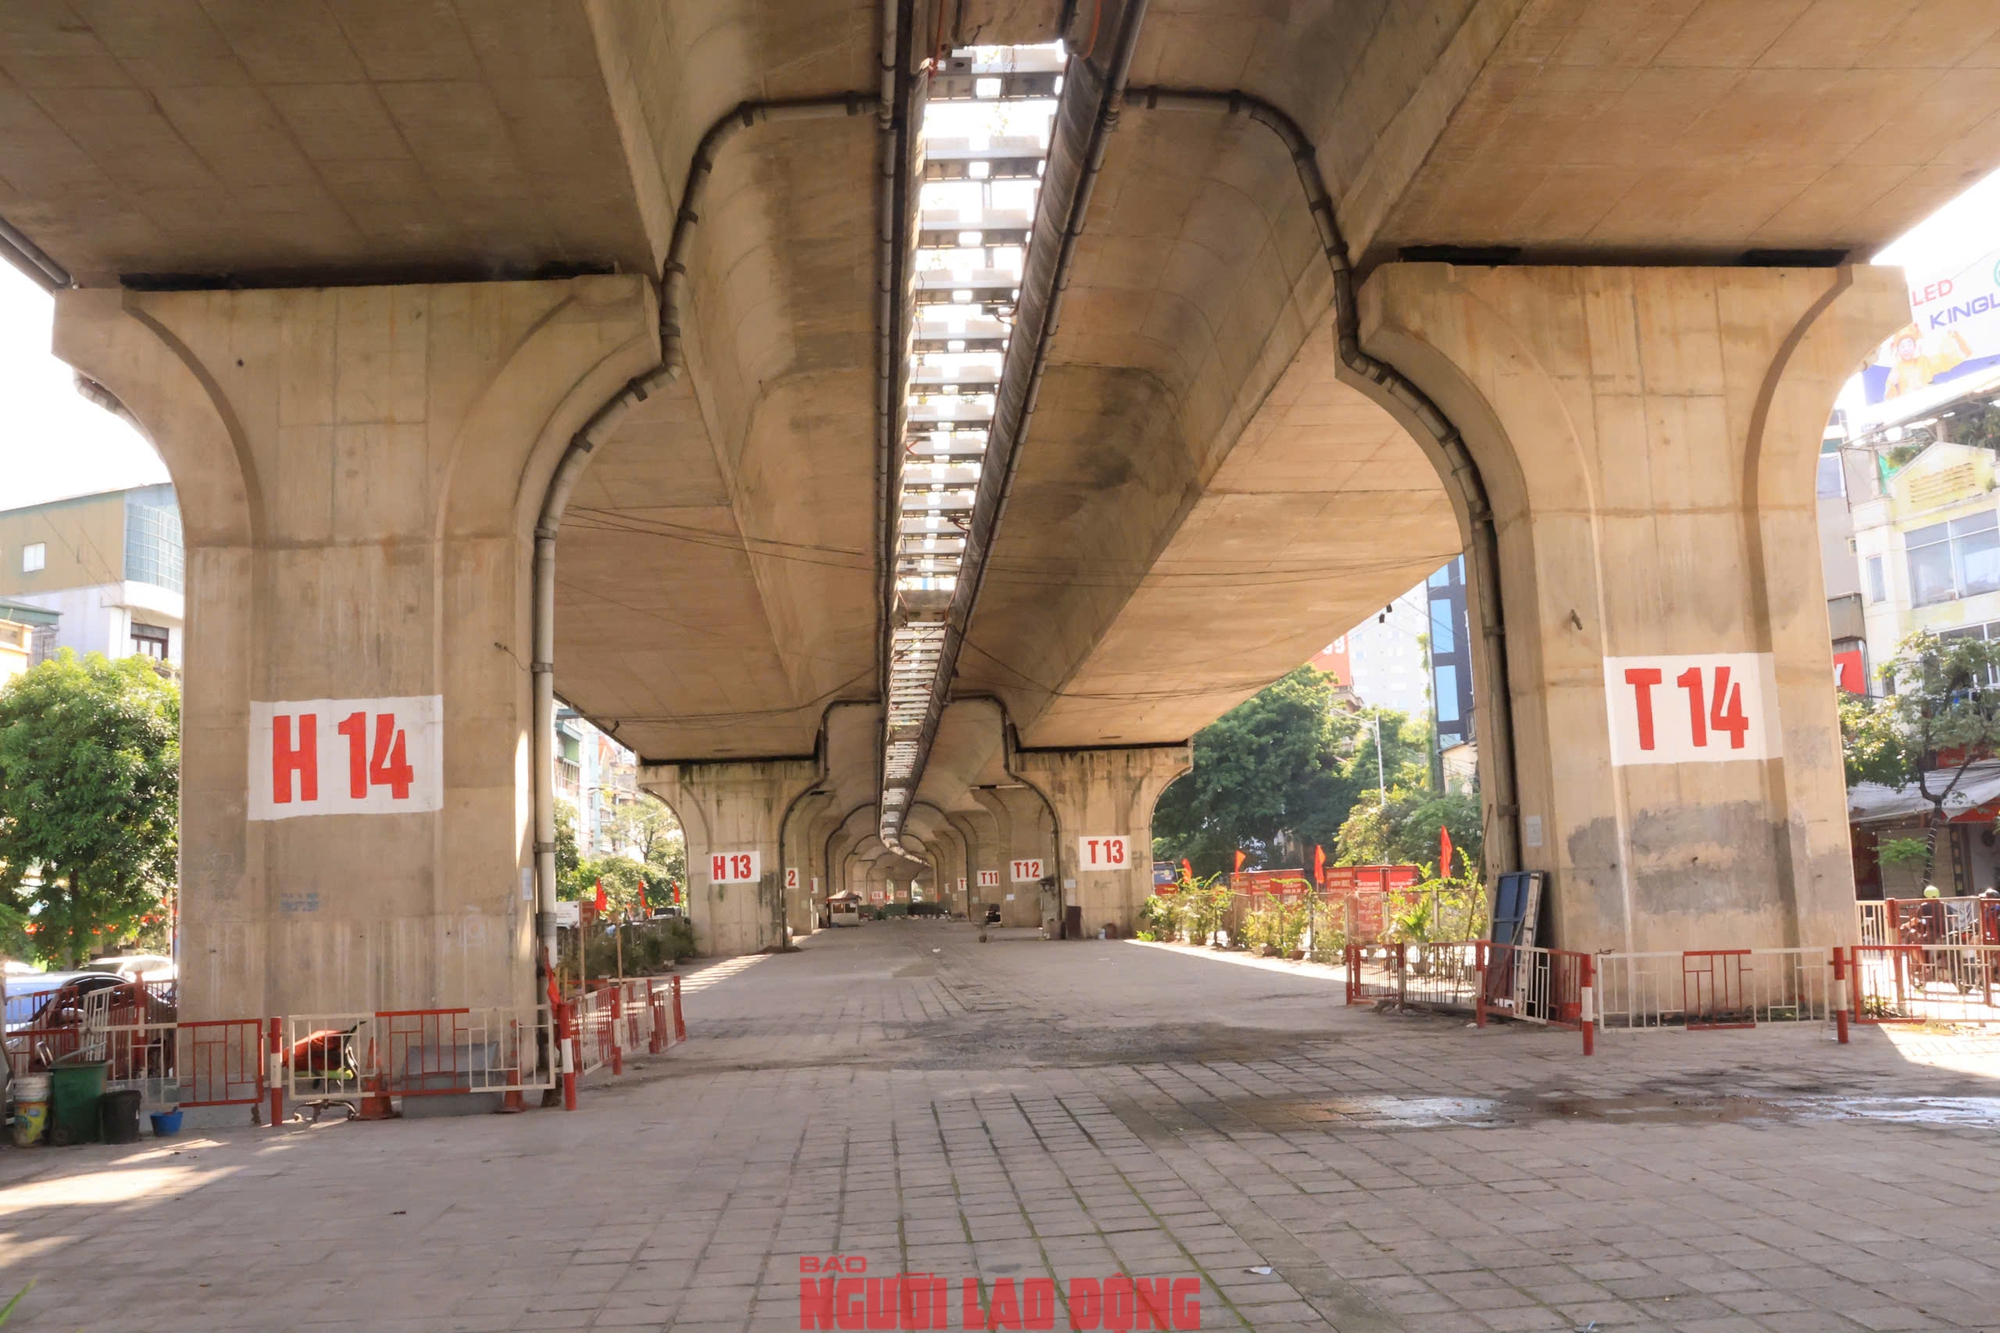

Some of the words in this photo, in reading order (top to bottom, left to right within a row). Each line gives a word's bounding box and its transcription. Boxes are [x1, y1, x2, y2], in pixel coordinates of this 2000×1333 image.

[1911, 279, 1953, 307] LED
[1624, 668, 1662, 751] T
[1676, 666, 1749, 749] 14
[273, 713, 318, 804] H
[338, 711, 414, 799] 14
[1087, 840, 1099, 864] T
[1103, 839, 1124, 864] 13
[713, 855, 726, 880] H
[730, 854, 752, 879] 13
[981, 872, 998, 885] T11
[1014, 861, 1040, 879] T12
